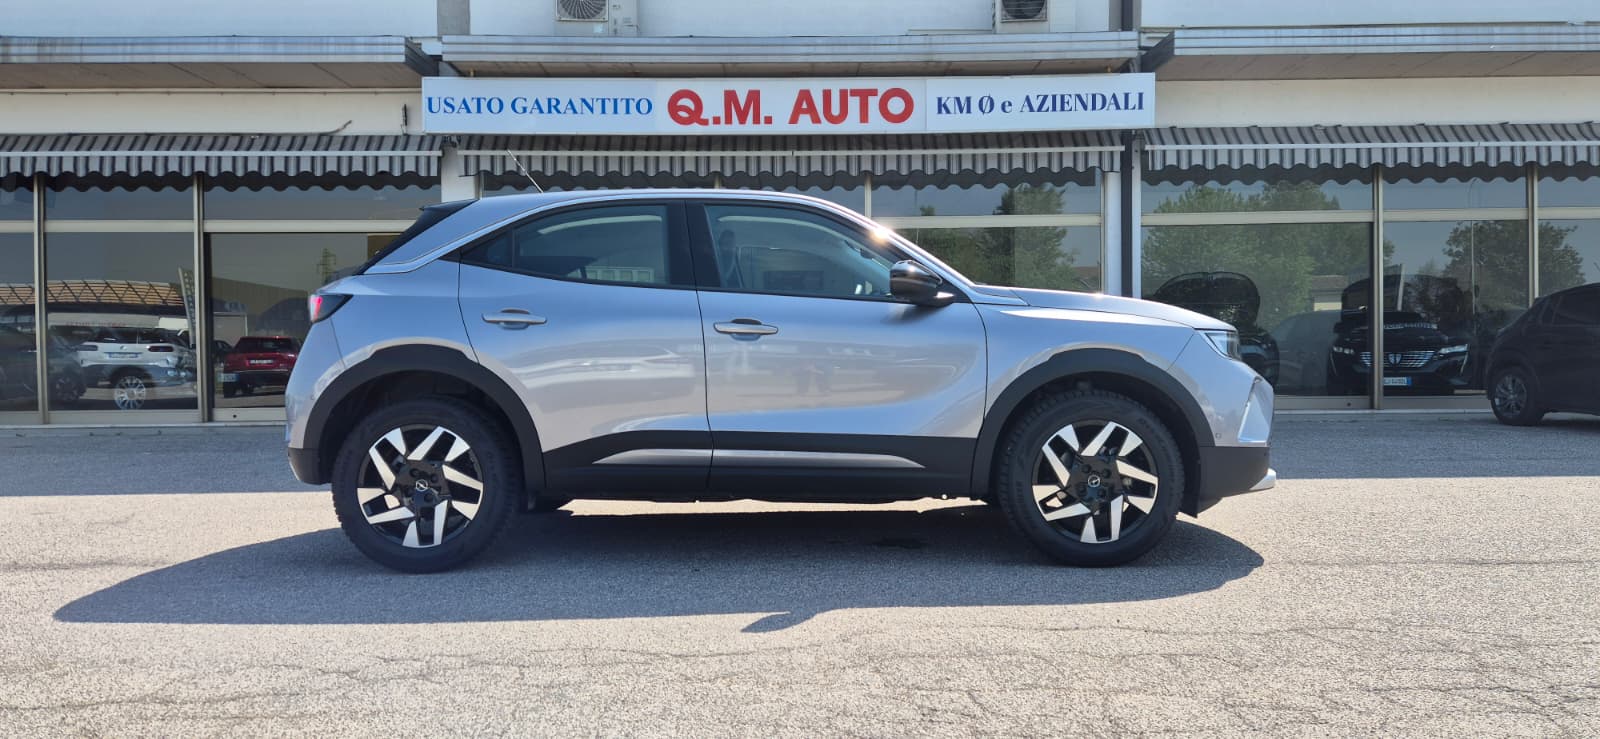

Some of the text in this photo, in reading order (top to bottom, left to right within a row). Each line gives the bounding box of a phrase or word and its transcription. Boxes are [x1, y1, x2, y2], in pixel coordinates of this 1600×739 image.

[426, 96, 653, 116] USATO GARANTITO
[668, 88, 915, 126] Q.M. AUTO
[936, 95, 973, 115] KM
[1000, 100, 1013, 114] e
[1020, 91, 1145, 113] AZIENDALI
